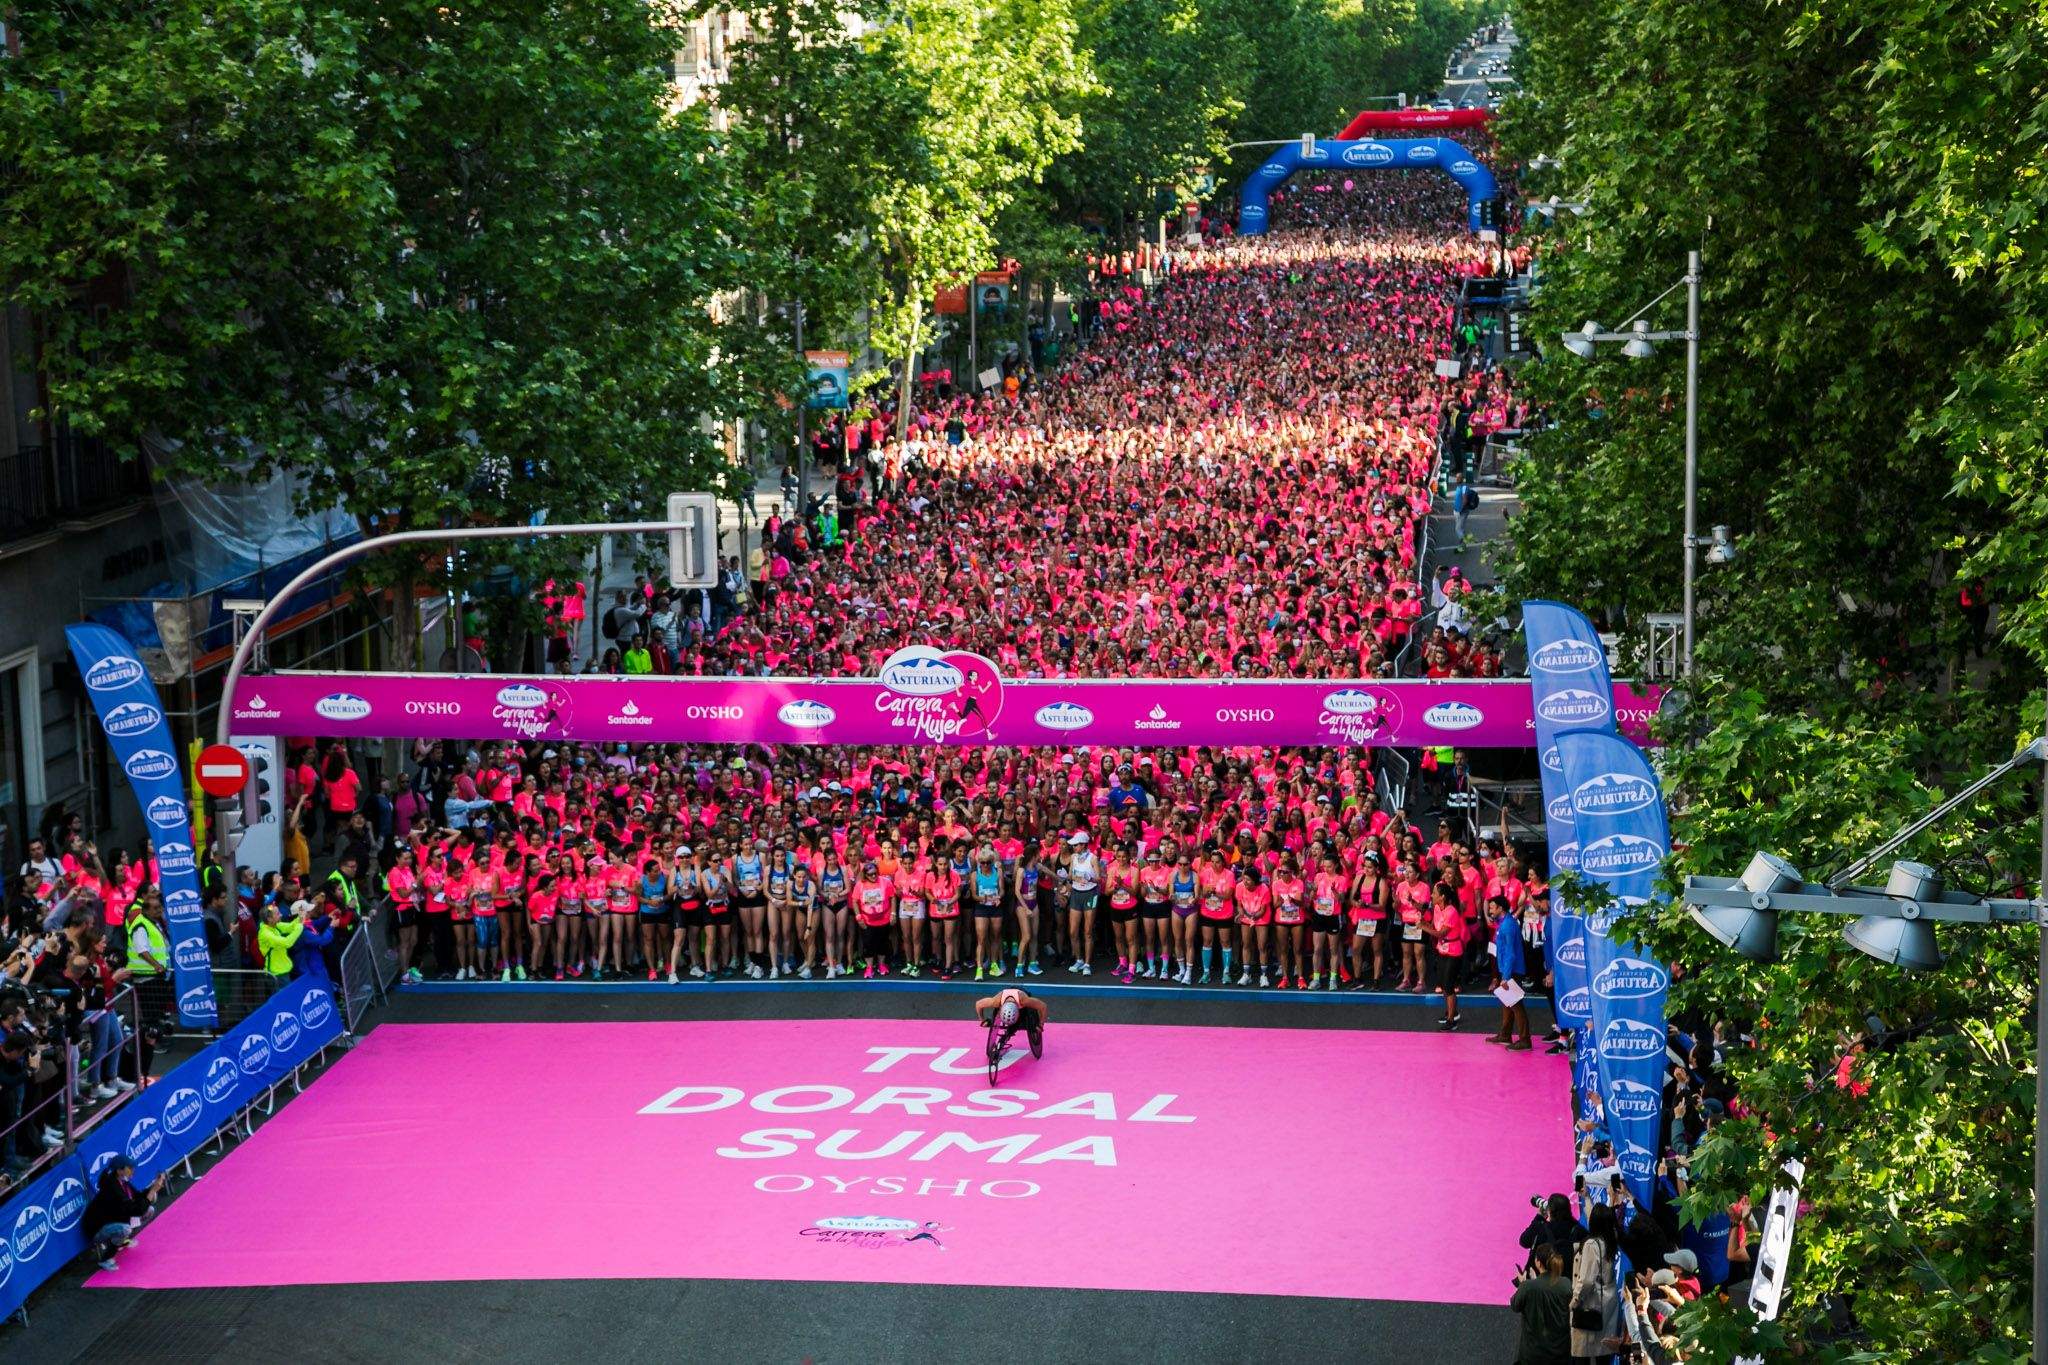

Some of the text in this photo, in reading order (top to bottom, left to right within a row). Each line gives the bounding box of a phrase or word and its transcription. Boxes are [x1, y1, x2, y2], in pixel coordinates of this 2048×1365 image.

[1347, 150, 1390, 161] ASTURIANA
[889, 671, 957, 685] ASTURIANA
[319, 702, 368, 713] ASTURIANA
[404, 701, 461, 715] OYSHO
[874, 691, 943, 712] Carrera
[1329, 698, 1374, 708] ASTURIANA
[234, 709, 281, 719] Santander
[492, 704, 535, 719] Carrera
[686, 705, 744, 720] OYSHO
[782, 709, 831, 721] ASTURIANA
[1039, 712, 1089, 723] ASTURIANA
[1216, 708, 1275, 722] OYSHO
[1318, 711, 1363, 725] Carrera
[1428, 711, 1479, 723] ASTURIANA
[516, 716, 551, 738] Mujer
[607, 715, 654, 725] Santander
[891, 710, 968, 743] de la Mujer
[1134, 719, 1182, 730] Santander
[1343, 722, 1379, 745] Mujer
[861, 1046, 1031, 1075] TU
[636, 1085, 1198, 1123] DORSAL
[715, 1127, 1118, 1167] SUMA
[753, 1174, 1042, 1199] OYSHO
[798, 1227, 886, 1239] Carrera
